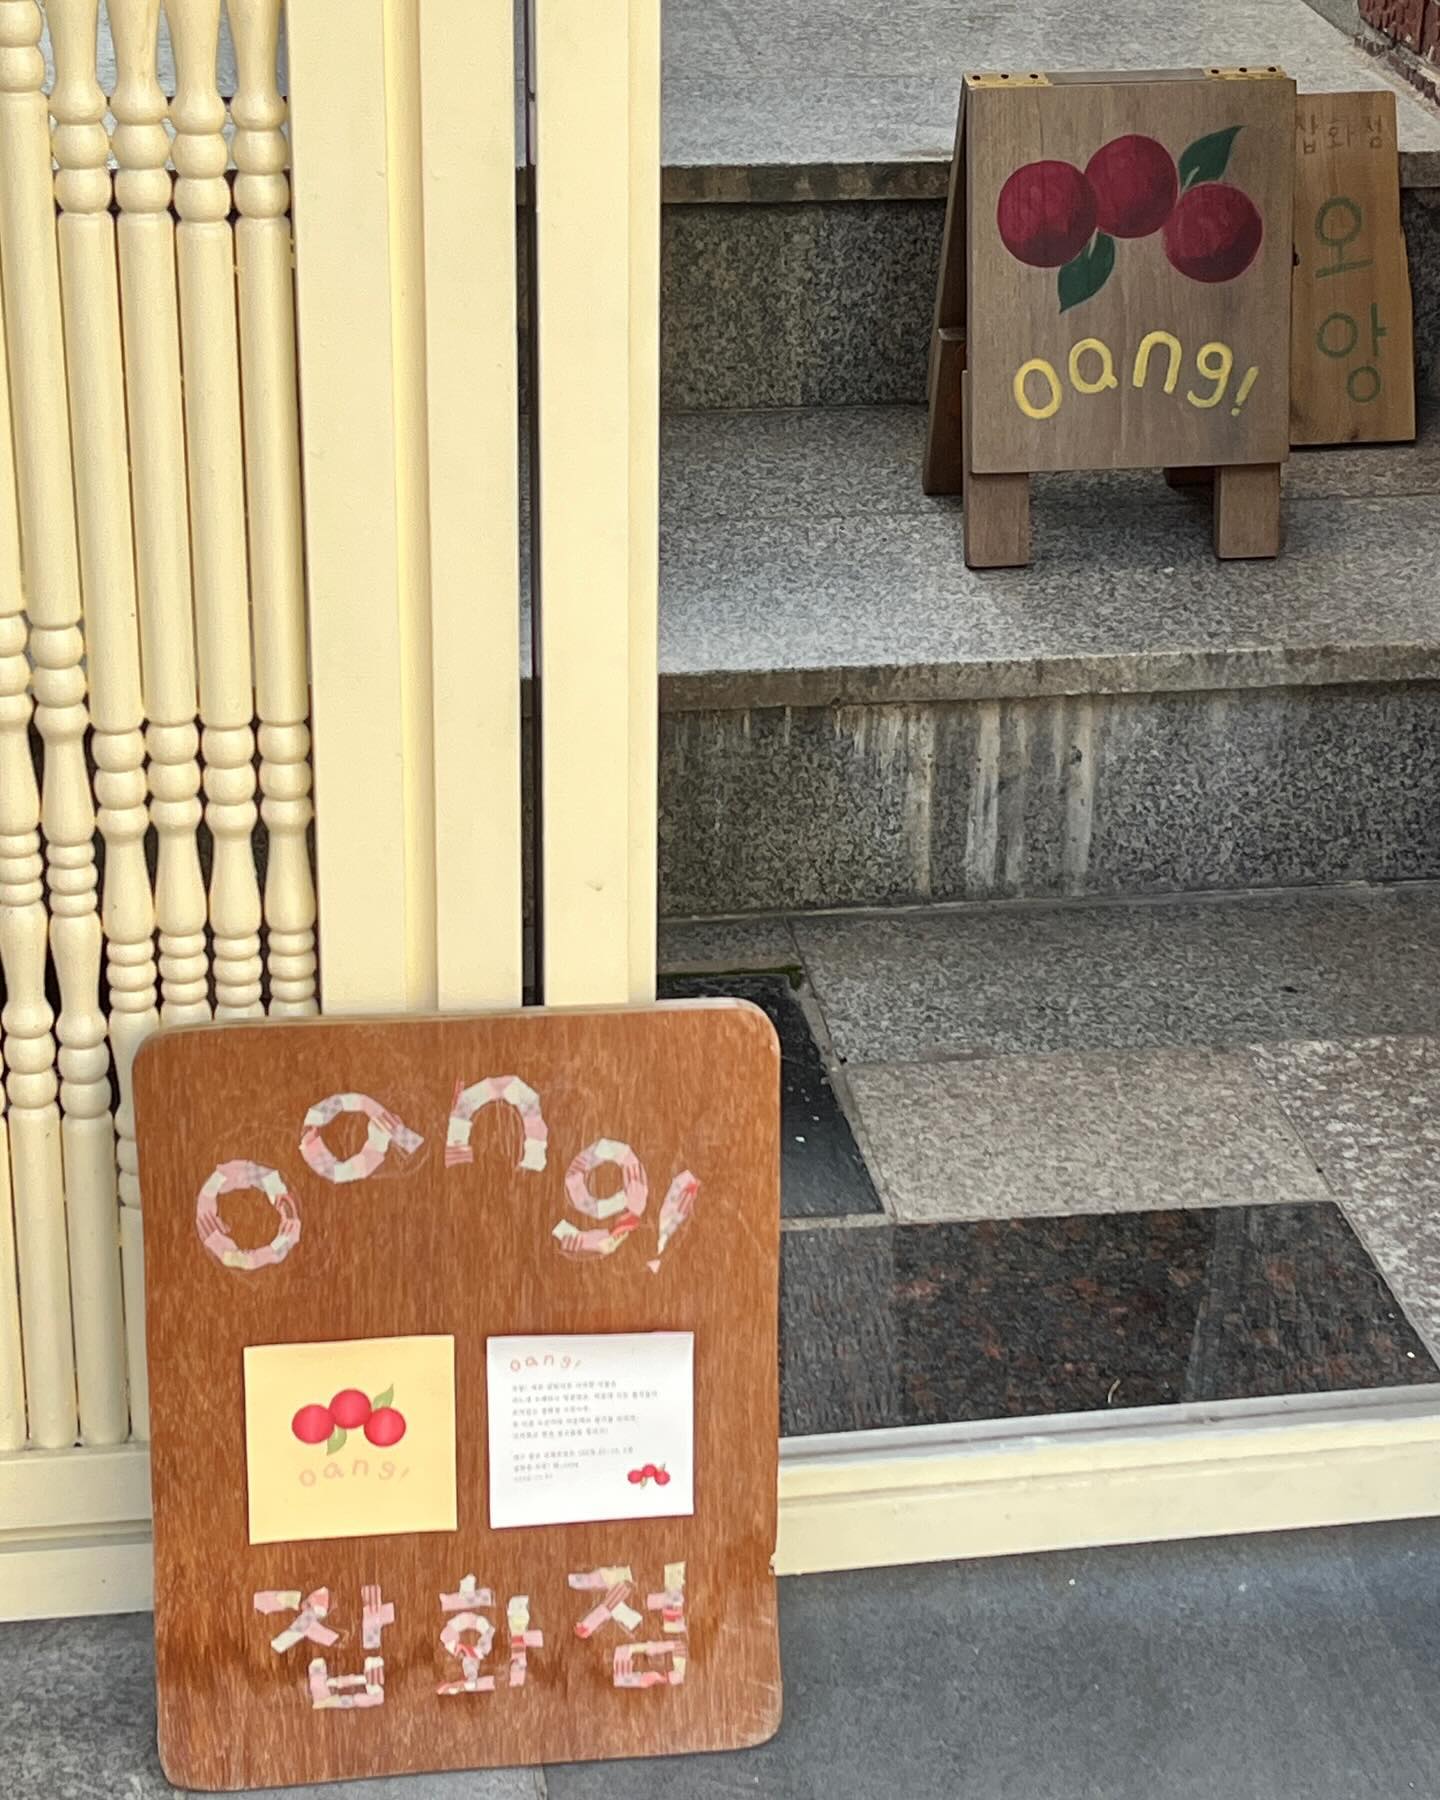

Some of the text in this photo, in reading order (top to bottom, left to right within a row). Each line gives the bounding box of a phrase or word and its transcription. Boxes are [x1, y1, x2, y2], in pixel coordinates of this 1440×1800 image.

[1013, 330, 1260, 420] oang!
[1314, 197, 1388, 403] 오앙
[196, 1075, 700, 1273] oang!
[253, 1560, 687, 1710] 잡화점
